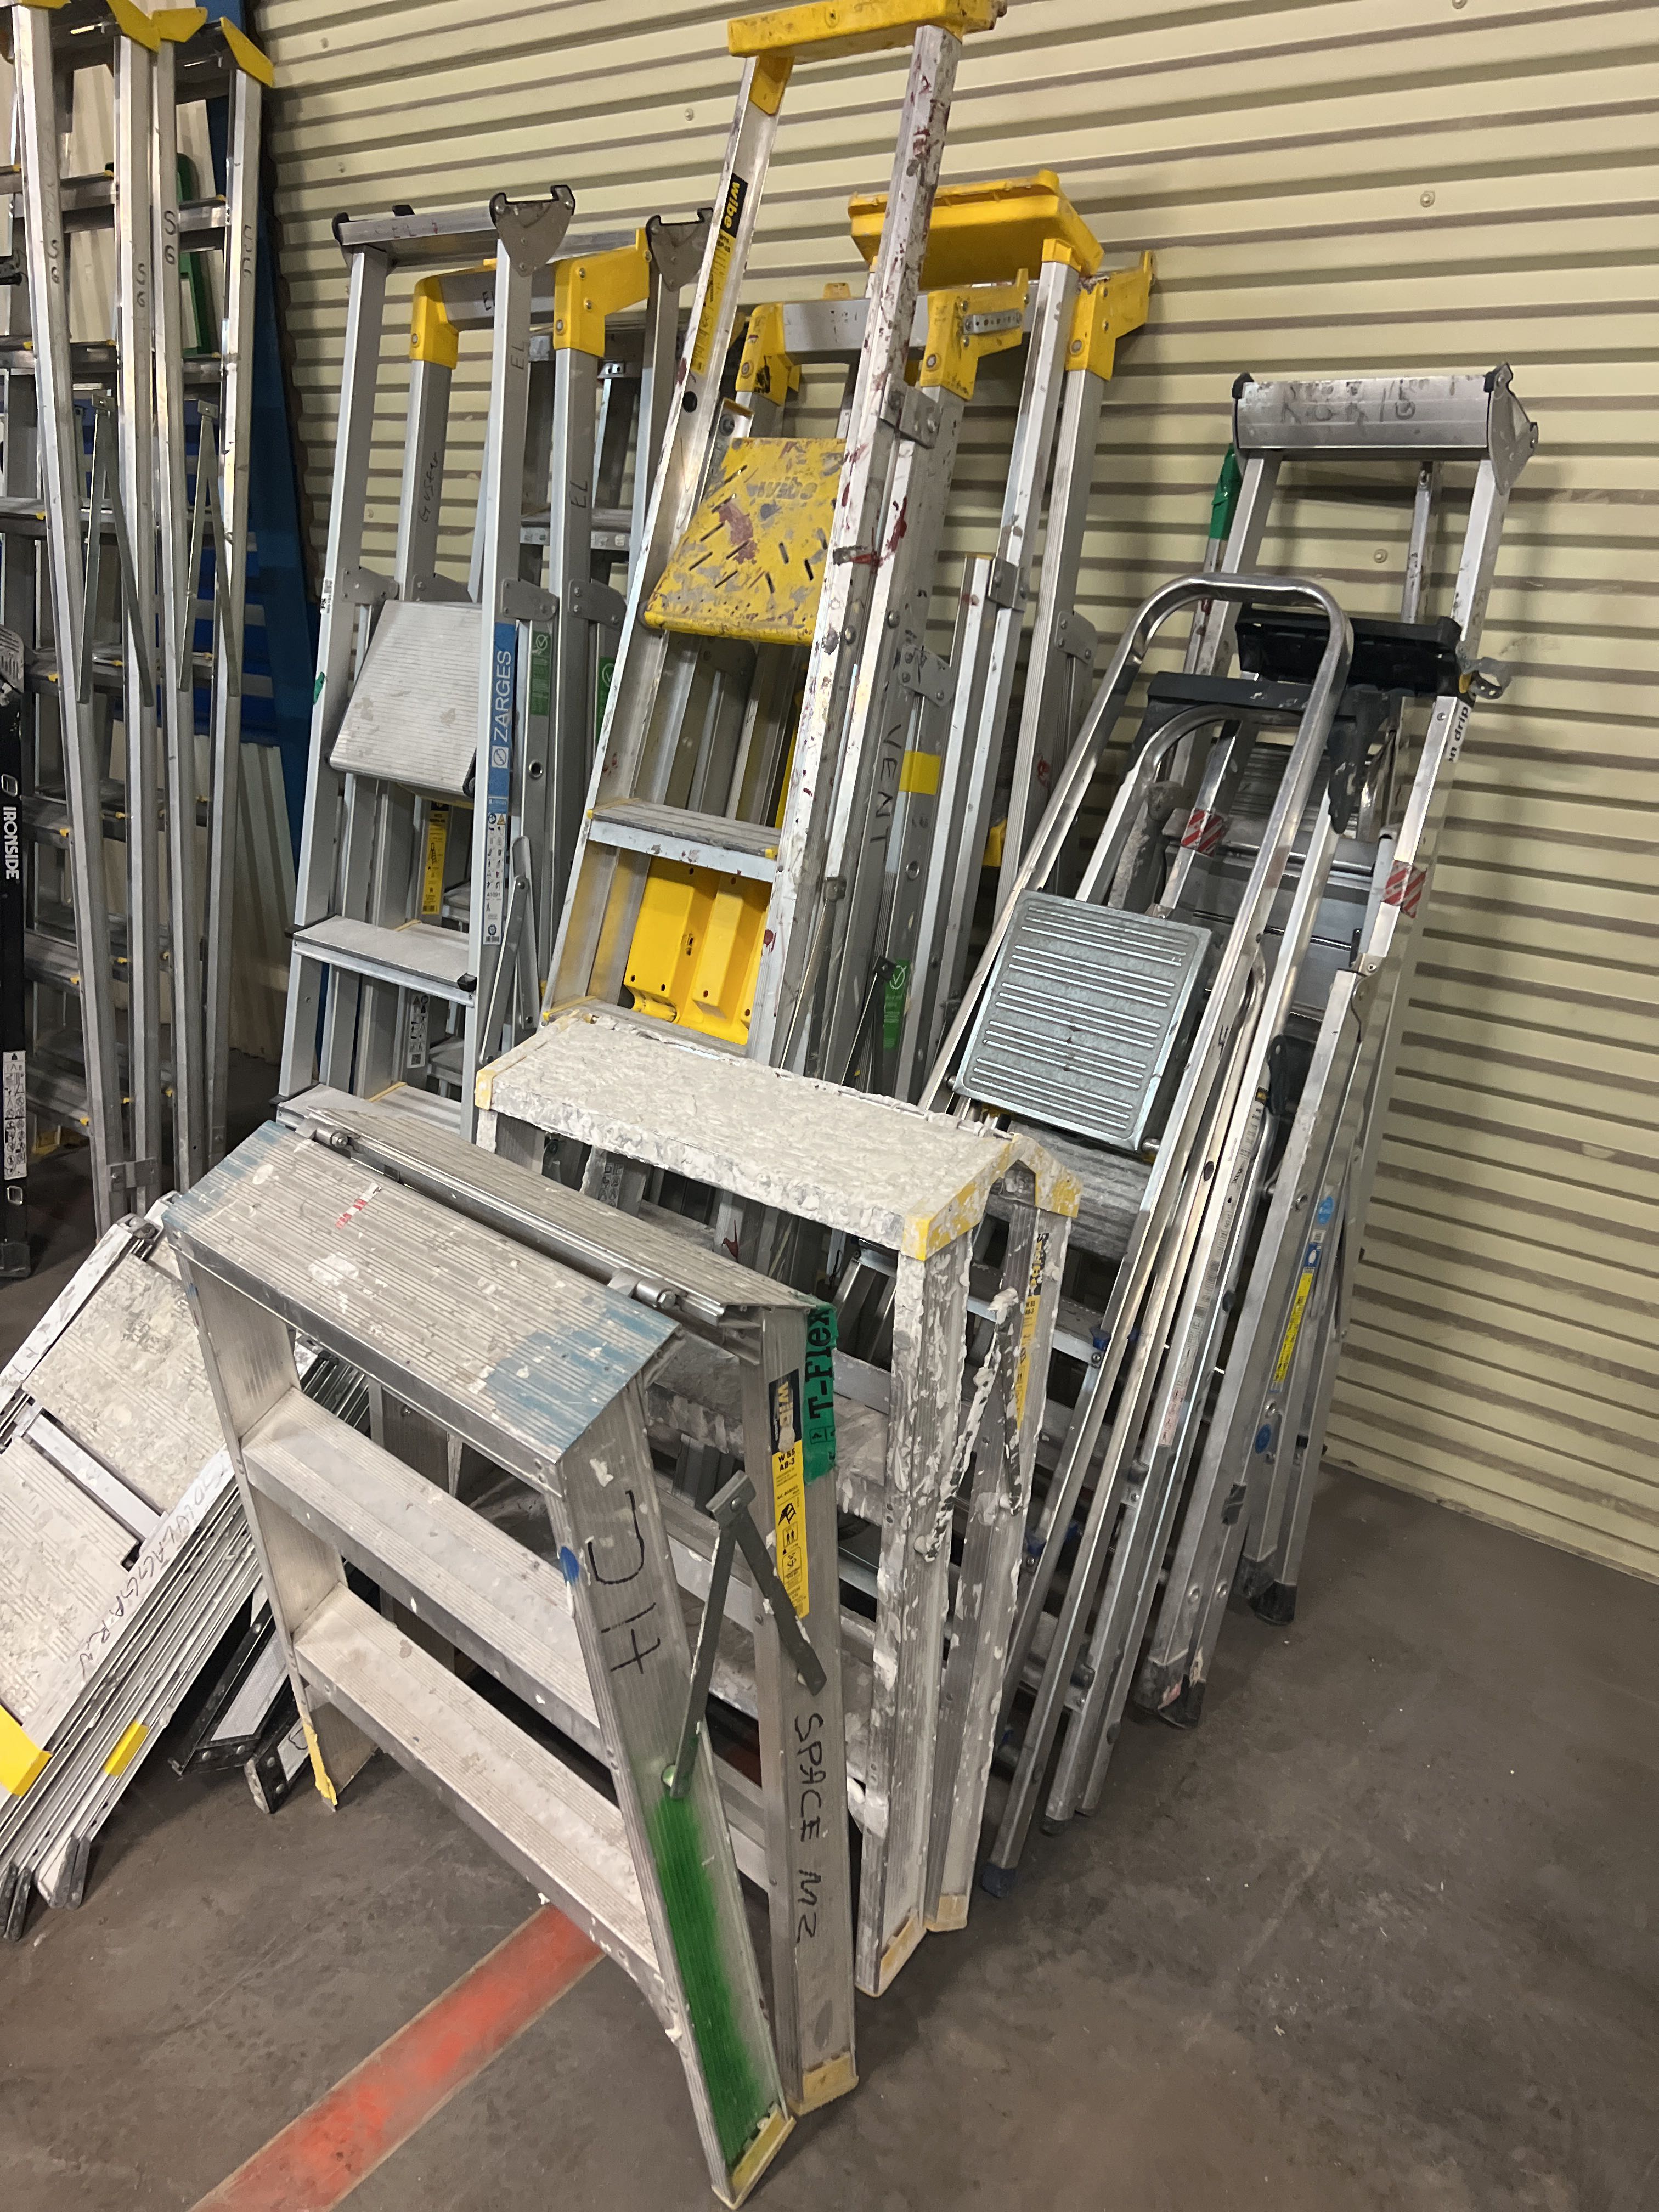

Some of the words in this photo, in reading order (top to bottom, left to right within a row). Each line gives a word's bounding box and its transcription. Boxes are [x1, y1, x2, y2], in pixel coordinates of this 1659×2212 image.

[722, 182, 741, 229] wibe
[494, 650, 512, 743] ZARGES
[1454, 706, 1469, 741] drip
[870, 724, 902, 862] VENT
[3, 806, 19, 879] IRONSIDE
[805, 1309, 834, 1419] T-Flex
[794, 1714, 825, 1841] SPACE
